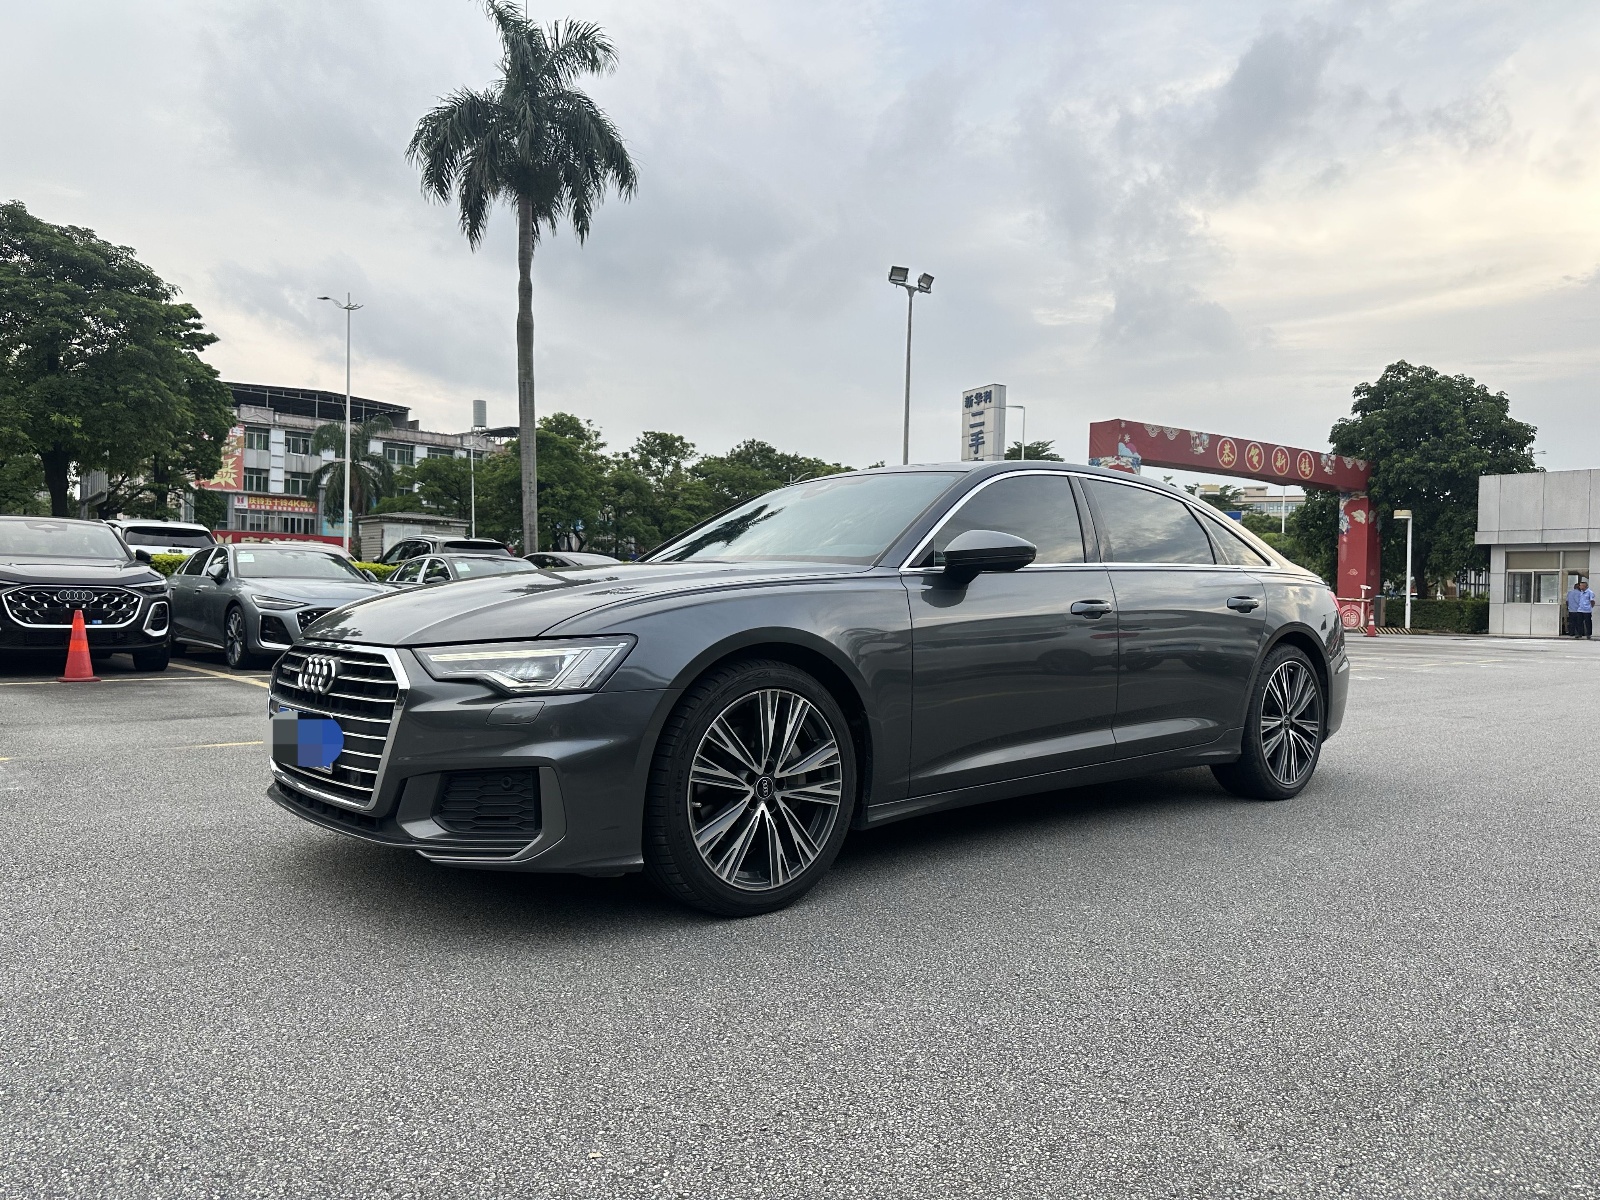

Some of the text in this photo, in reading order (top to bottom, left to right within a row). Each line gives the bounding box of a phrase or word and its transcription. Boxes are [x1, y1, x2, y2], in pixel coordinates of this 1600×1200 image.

[969, 411, 985, 461] 二手
[1220, 441, 1312, 476] 恭贺新禧
